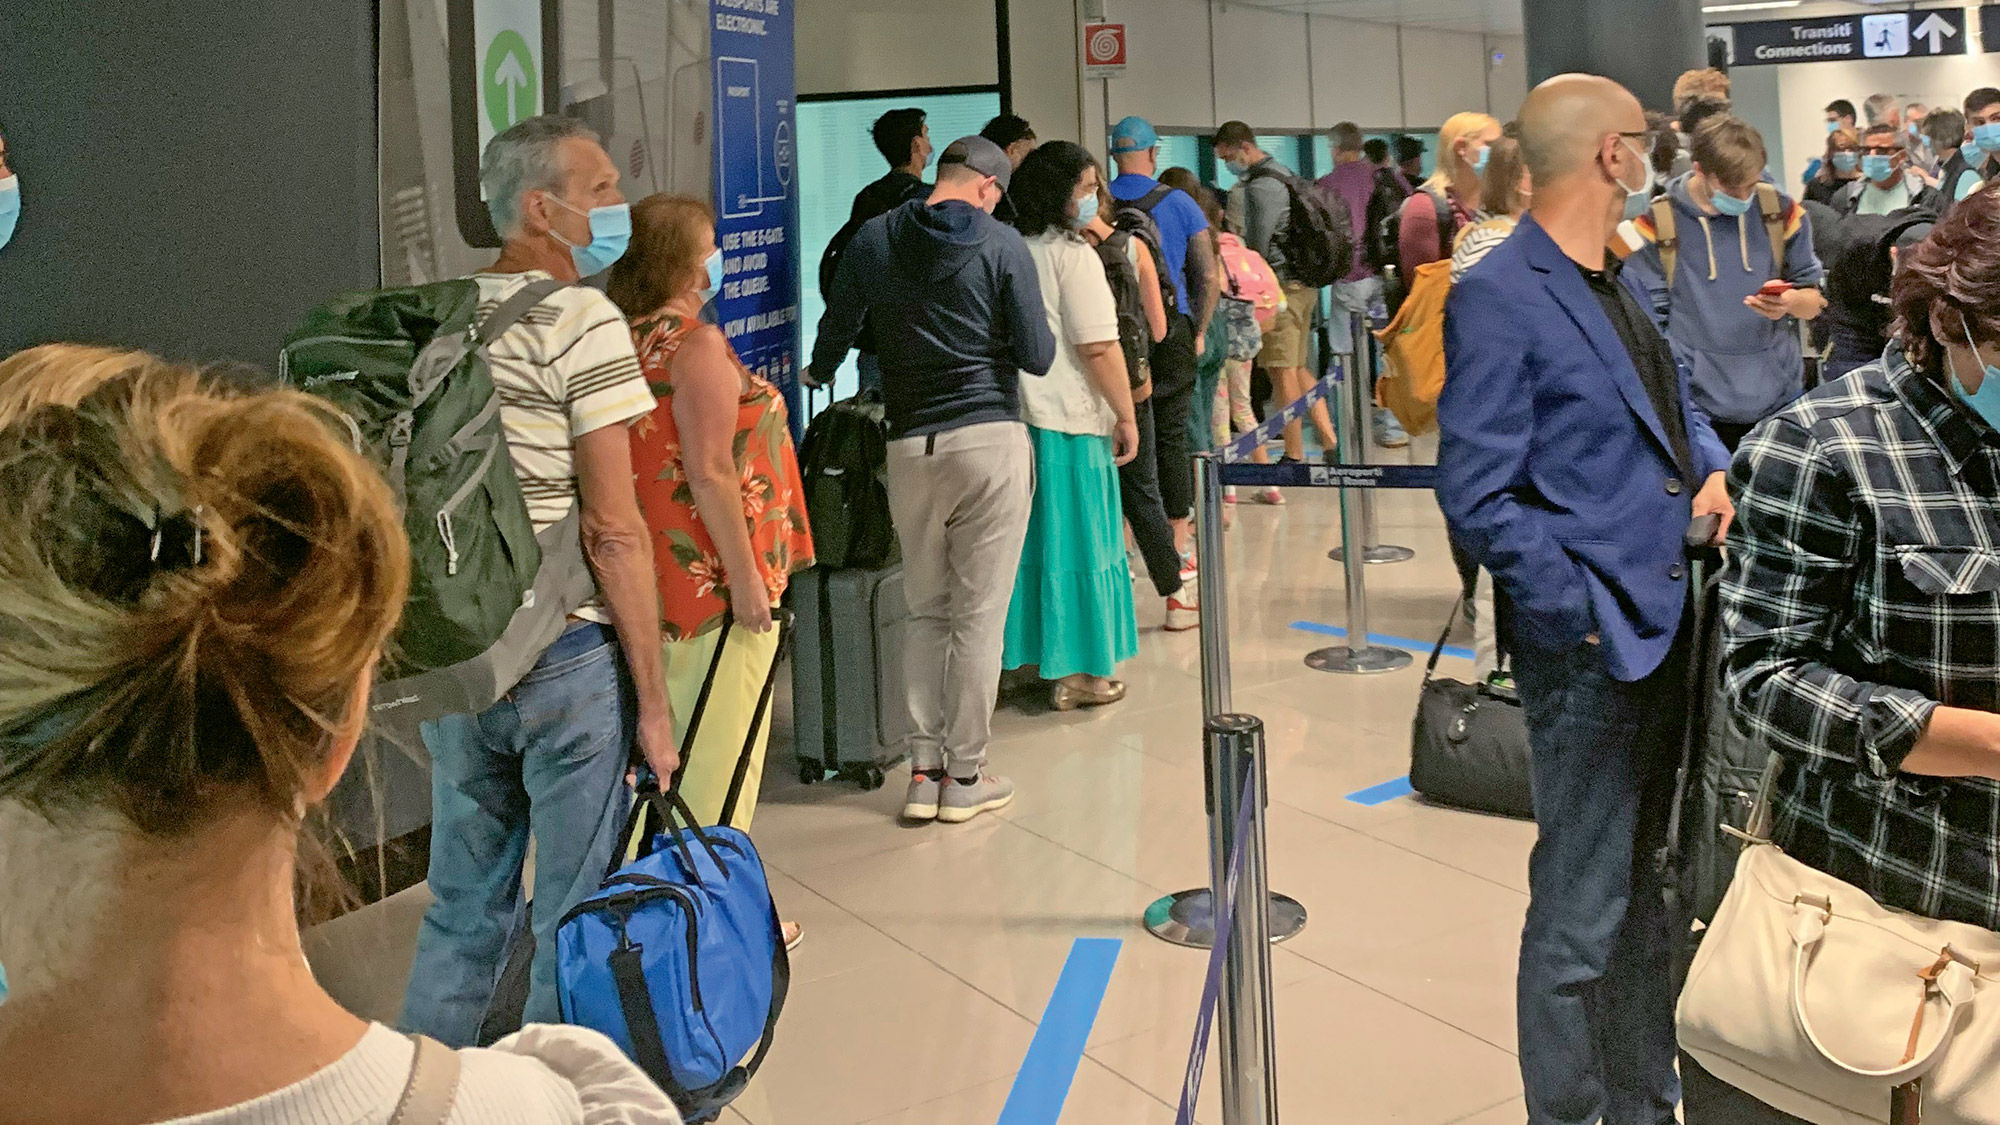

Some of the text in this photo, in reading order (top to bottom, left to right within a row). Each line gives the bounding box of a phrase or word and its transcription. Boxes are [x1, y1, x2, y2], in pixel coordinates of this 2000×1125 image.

[1791, 23, 1851, 40] Transiti
[1755, 42, 1852, 60] Connections
[722, 227, 784, 251] USE THE E-GATE
[723, 253, 768, 275] AND AVOID
[723, 276, 771, 300] THE QUEUE.
[724, 318, 745, 339] NOW
[746, 309, 785, 334] AVAILABLE
